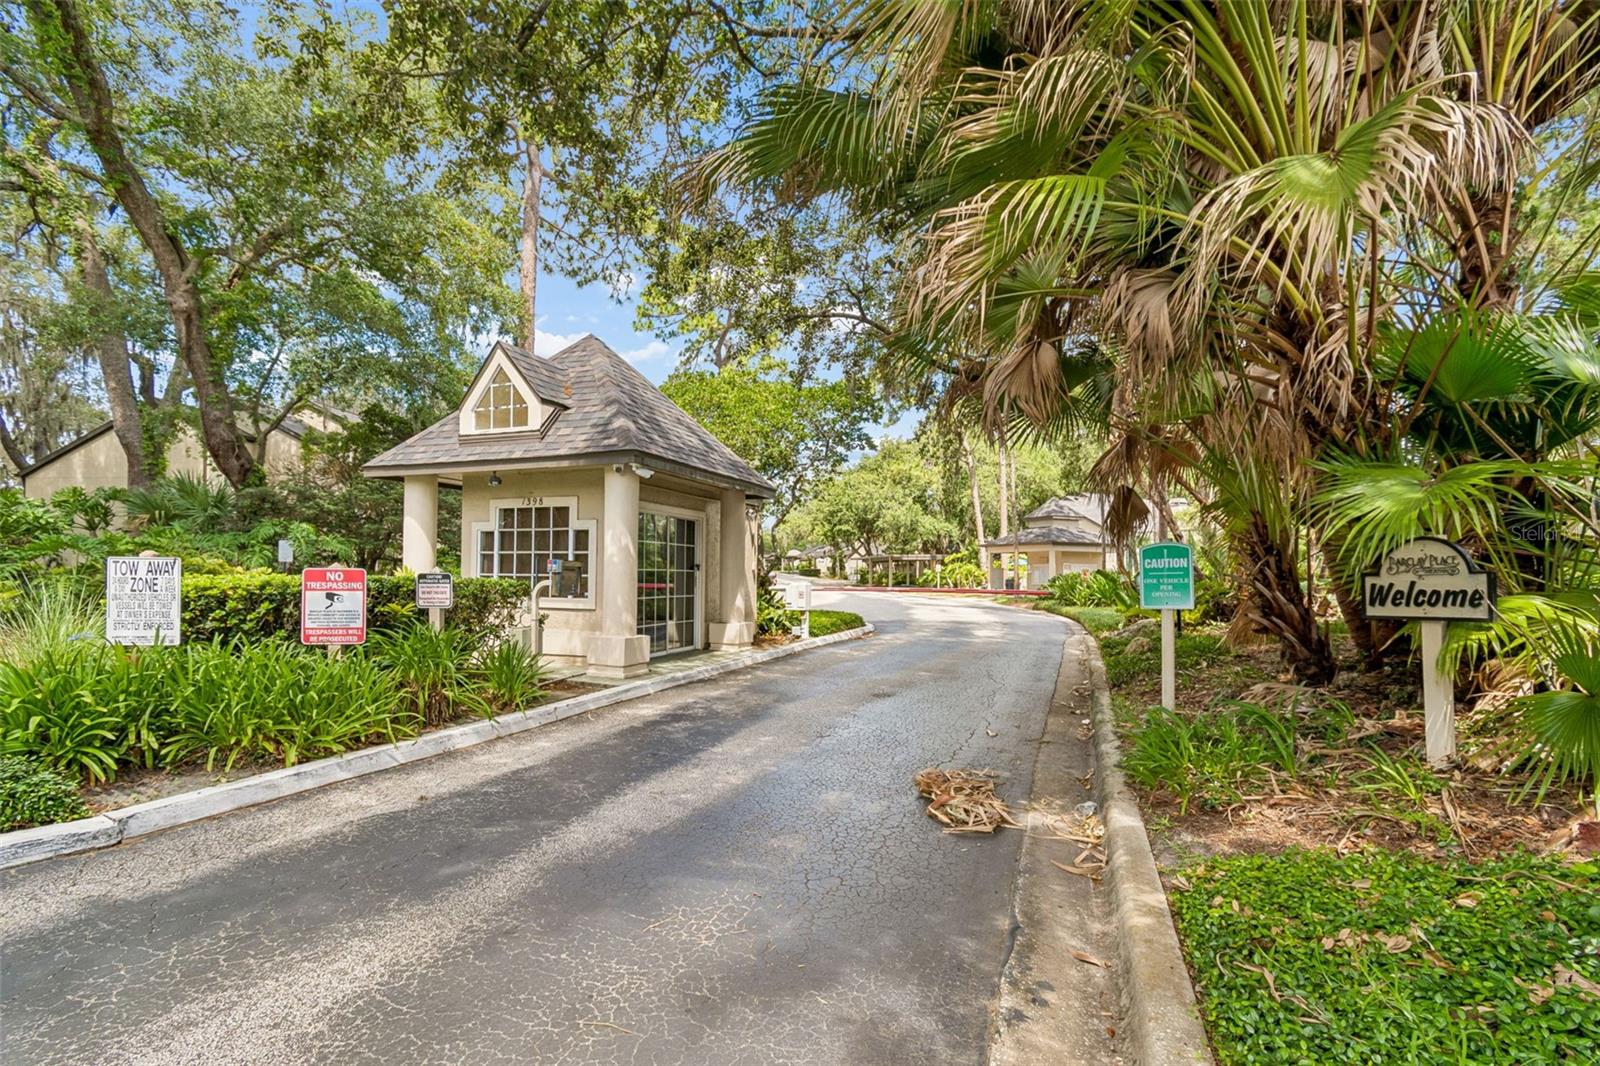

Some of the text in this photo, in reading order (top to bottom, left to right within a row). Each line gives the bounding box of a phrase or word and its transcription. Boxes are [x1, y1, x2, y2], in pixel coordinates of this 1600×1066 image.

[521, 496, 543, 506] 1398
[1144, 558, 1188, 569] CAUTION
[1429, 554, 1459, 567] PLACE
[112, 560, 177, 576] TOW AWAY
[326, 571, 344, 581] NO
[130, 577, 159, 593] ZONE
[306, 581, 363, 589] TRESPASSING
[112, 594, 177, 602] UNAUTHORIZED VEHICLES OR
[1368, 581, 1486, 608] Welcome
[117, 610, 123, 618] AT
[149, 610, 171, 619] EXPENSE
[113, 622, 175, 631] STRICTLY ENFORCED
